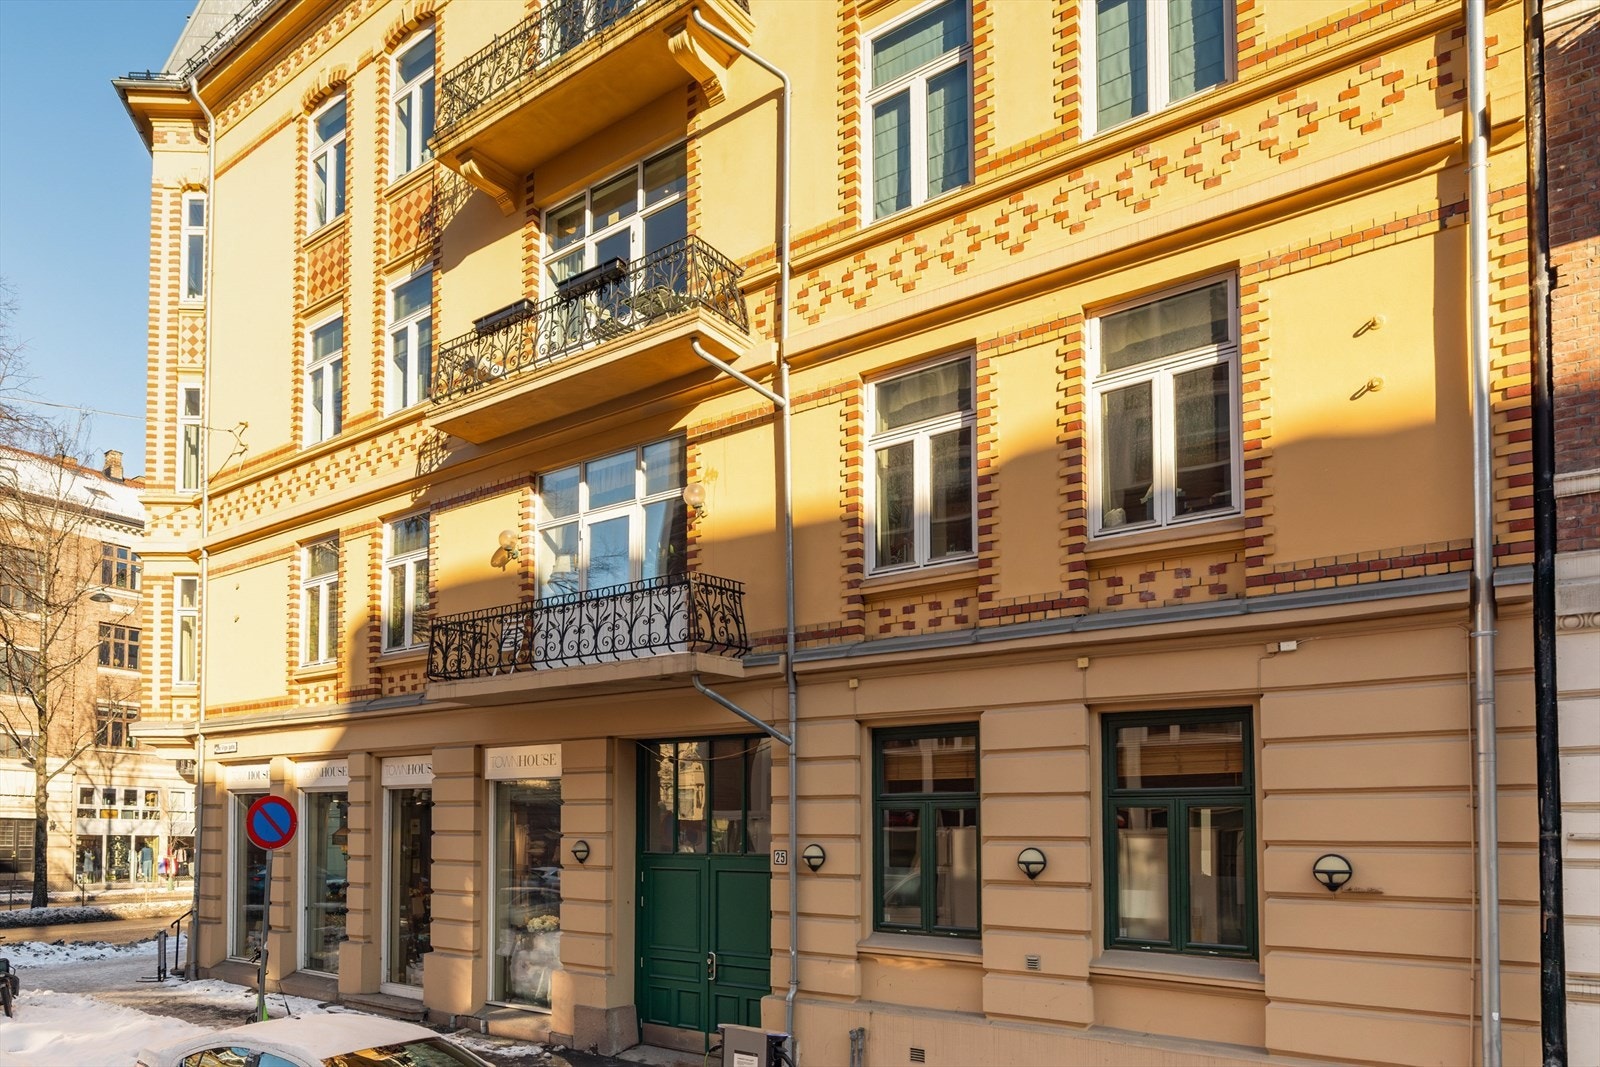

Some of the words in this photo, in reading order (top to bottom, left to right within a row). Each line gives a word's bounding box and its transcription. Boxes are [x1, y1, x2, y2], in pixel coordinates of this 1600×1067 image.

[490, 753, 557, 769] TOWNHOUSE
[384, 763, 432, 777] TOWNHOUS
[776, 852, 785, 863] 25
